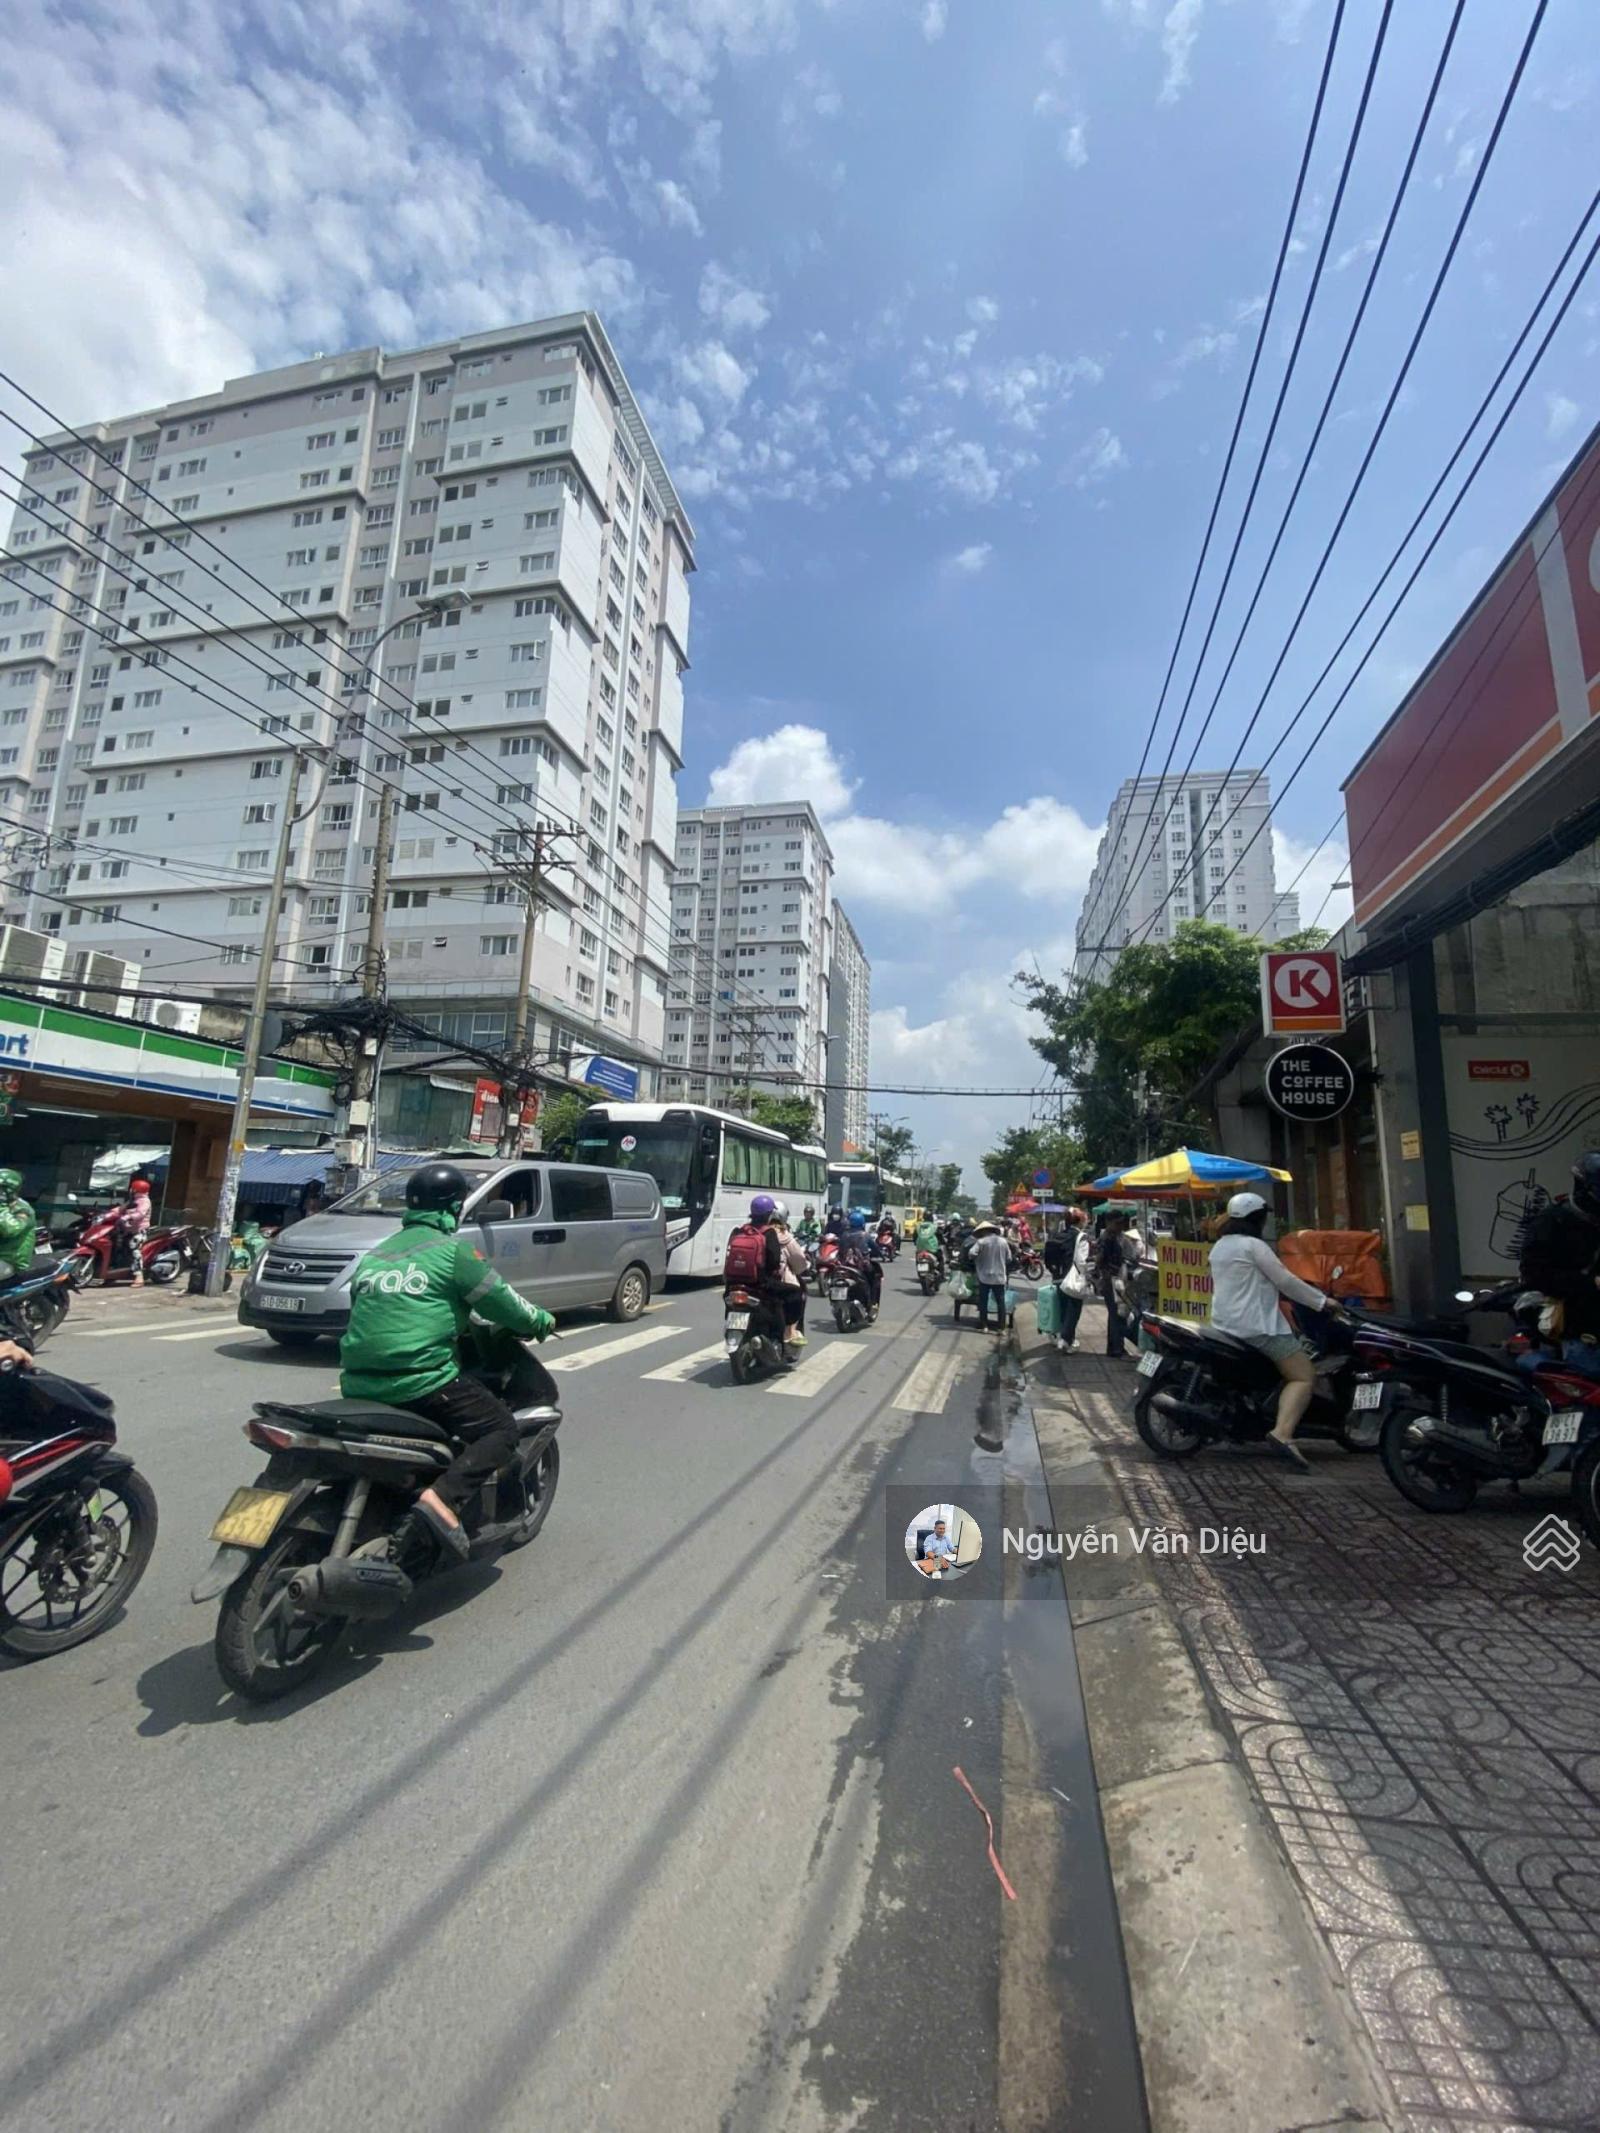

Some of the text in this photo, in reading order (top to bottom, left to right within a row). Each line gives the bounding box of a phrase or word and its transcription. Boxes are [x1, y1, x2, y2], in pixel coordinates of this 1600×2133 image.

[1289, 969, 1328, 1003] K
[1281, 1060, 1311, 1072] THE
[1281, 1076, 1344, 1089] COFFEE
[1282, 1093, 1336, 1105] HOUSE
